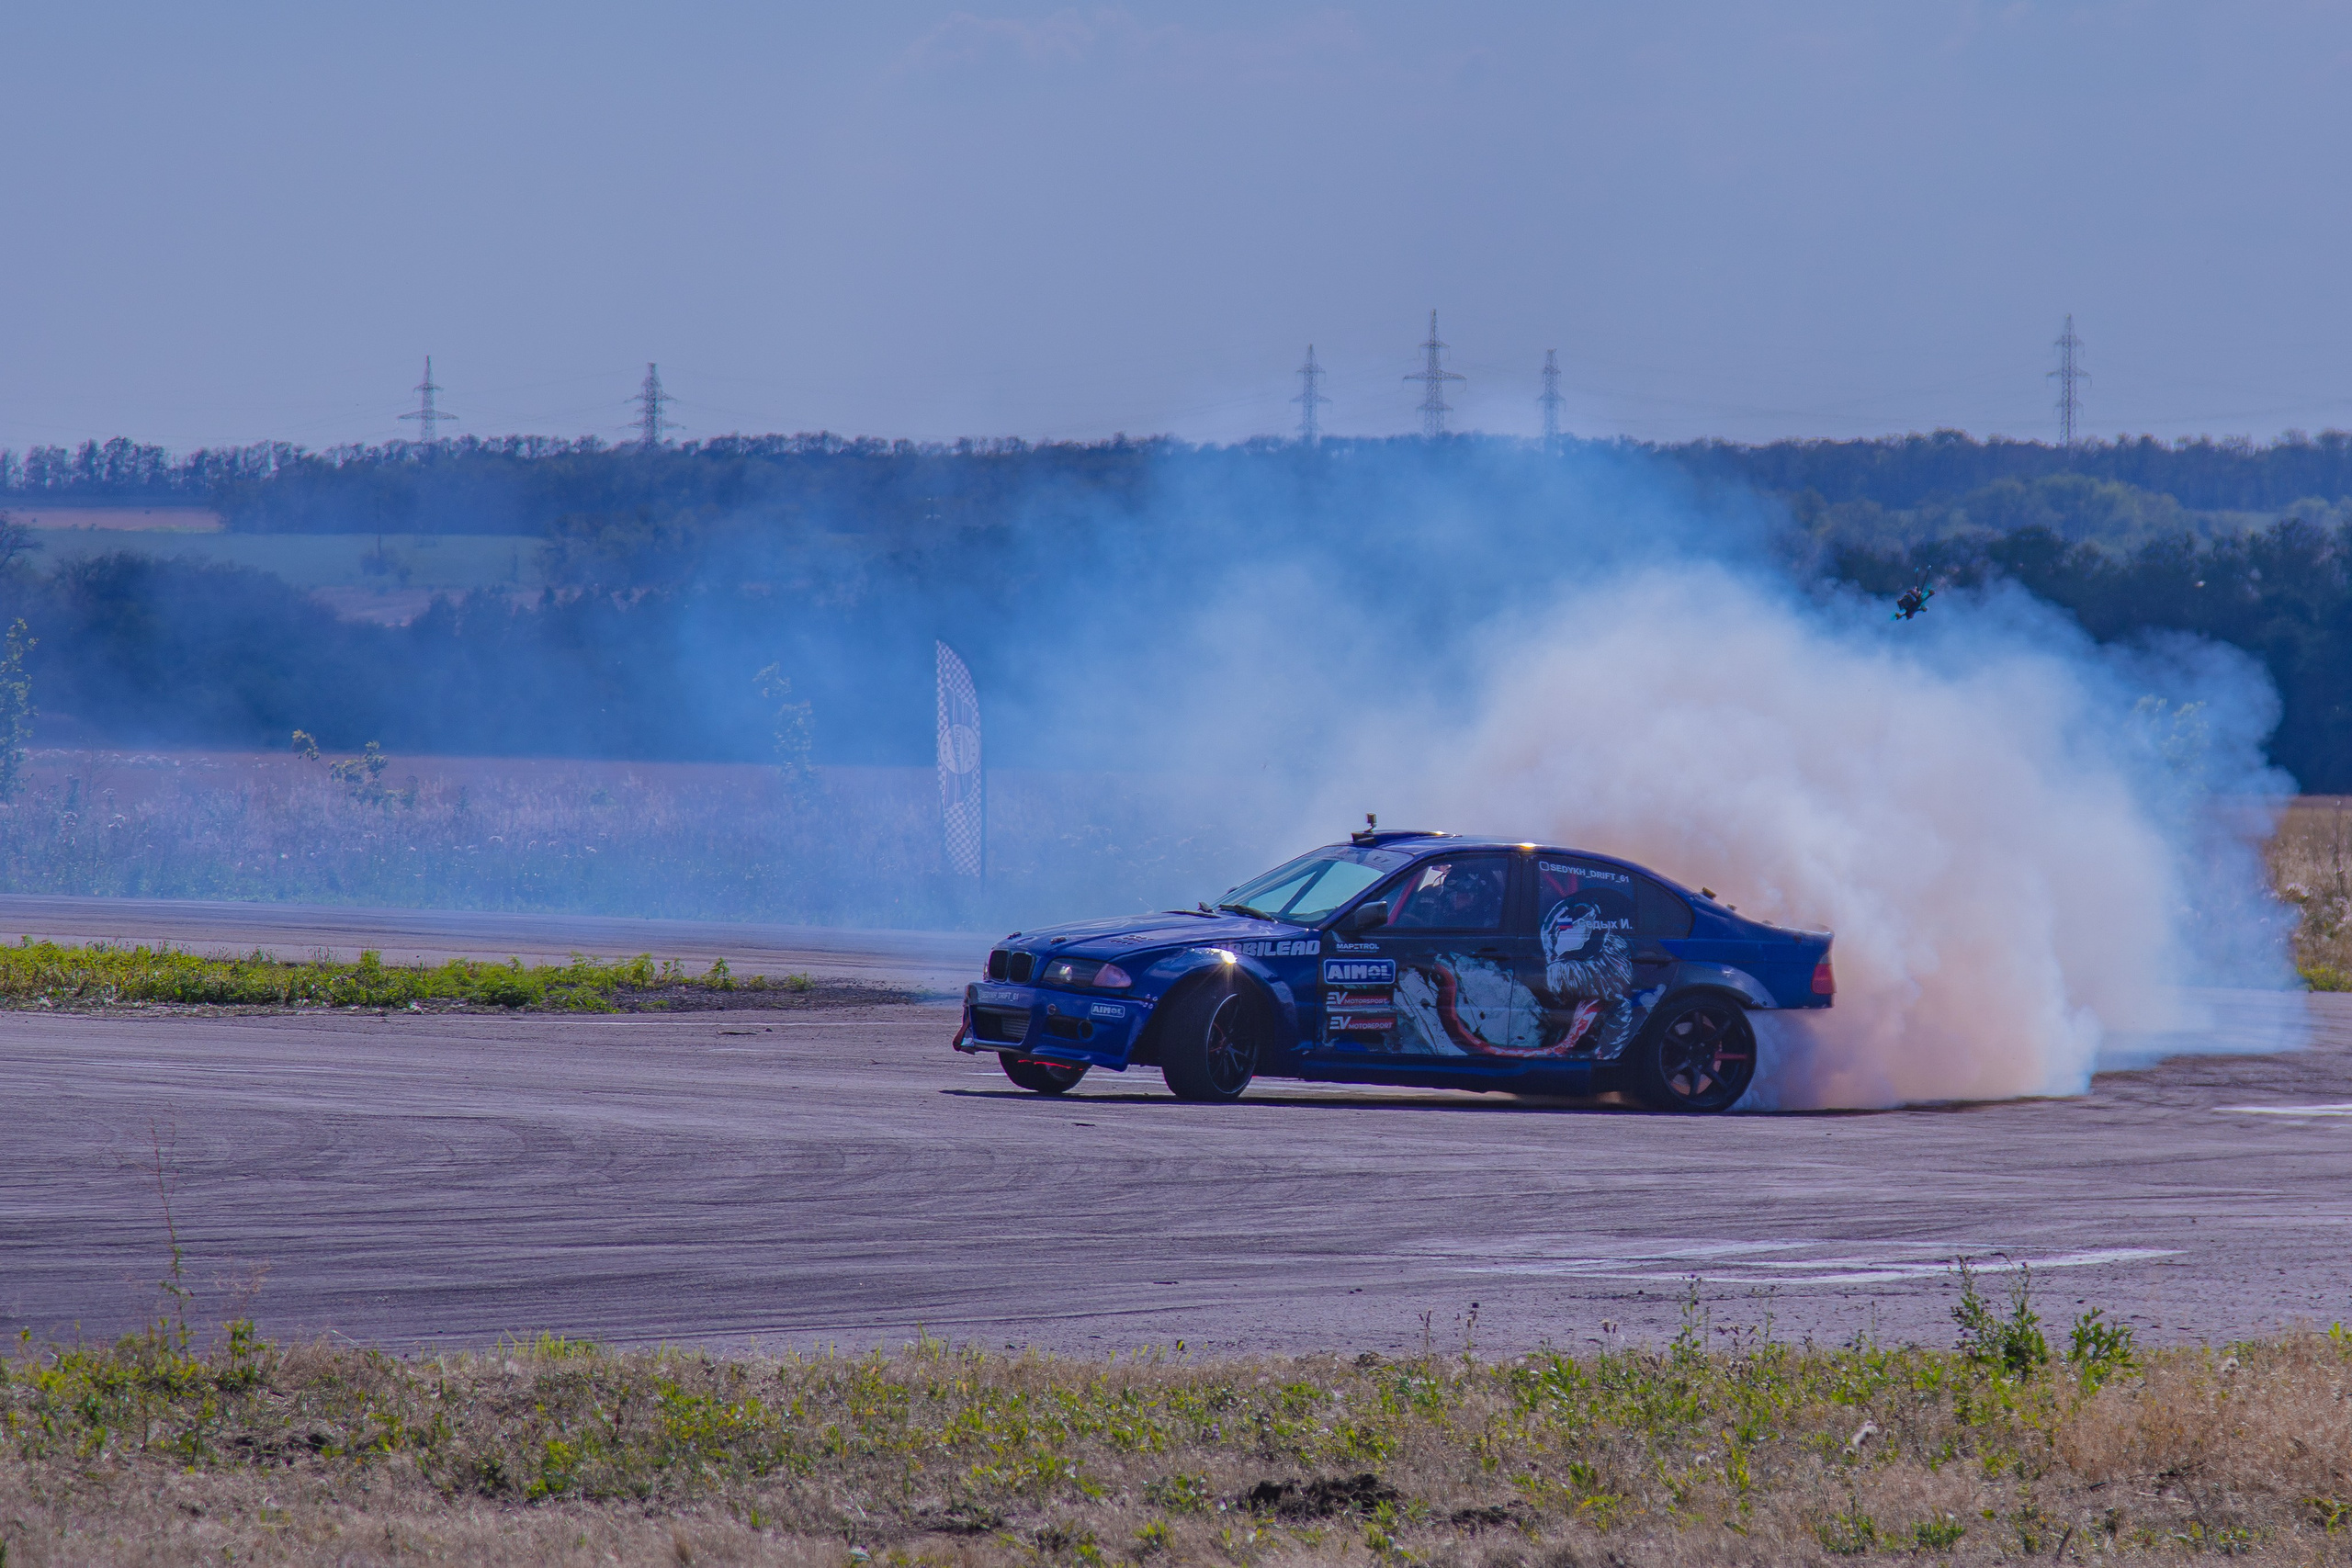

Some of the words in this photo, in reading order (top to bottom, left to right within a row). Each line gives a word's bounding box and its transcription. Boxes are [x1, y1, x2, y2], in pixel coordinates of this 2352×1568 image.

[1550, 864, 1630, 883] SEDYKH_DRIFT_61
[1620, 919, 1634, 930] И.
[1327, 965, 1392, 980] AIMOL
